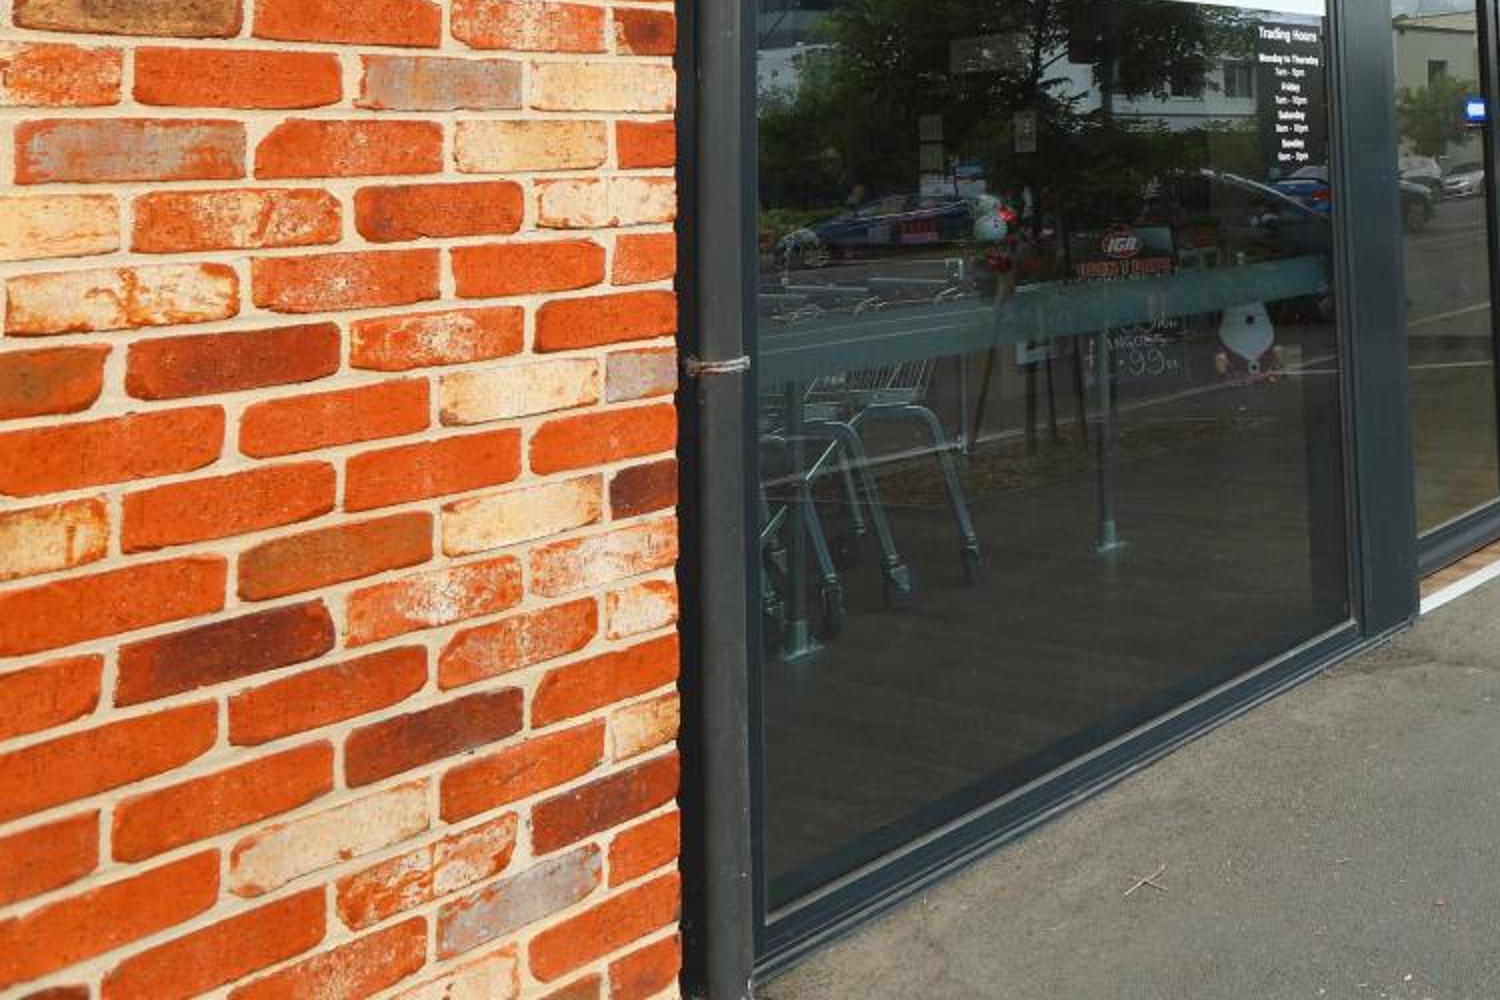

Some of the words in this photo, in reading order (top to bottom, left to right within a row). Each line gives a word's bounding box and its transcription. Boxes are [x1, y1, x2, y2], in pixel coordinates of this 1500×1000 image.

[1258, 26, 1290, 43] Trading
[1292, 29, 1317, 43] Hours
[1103, 235, 1137, 253] IGA
